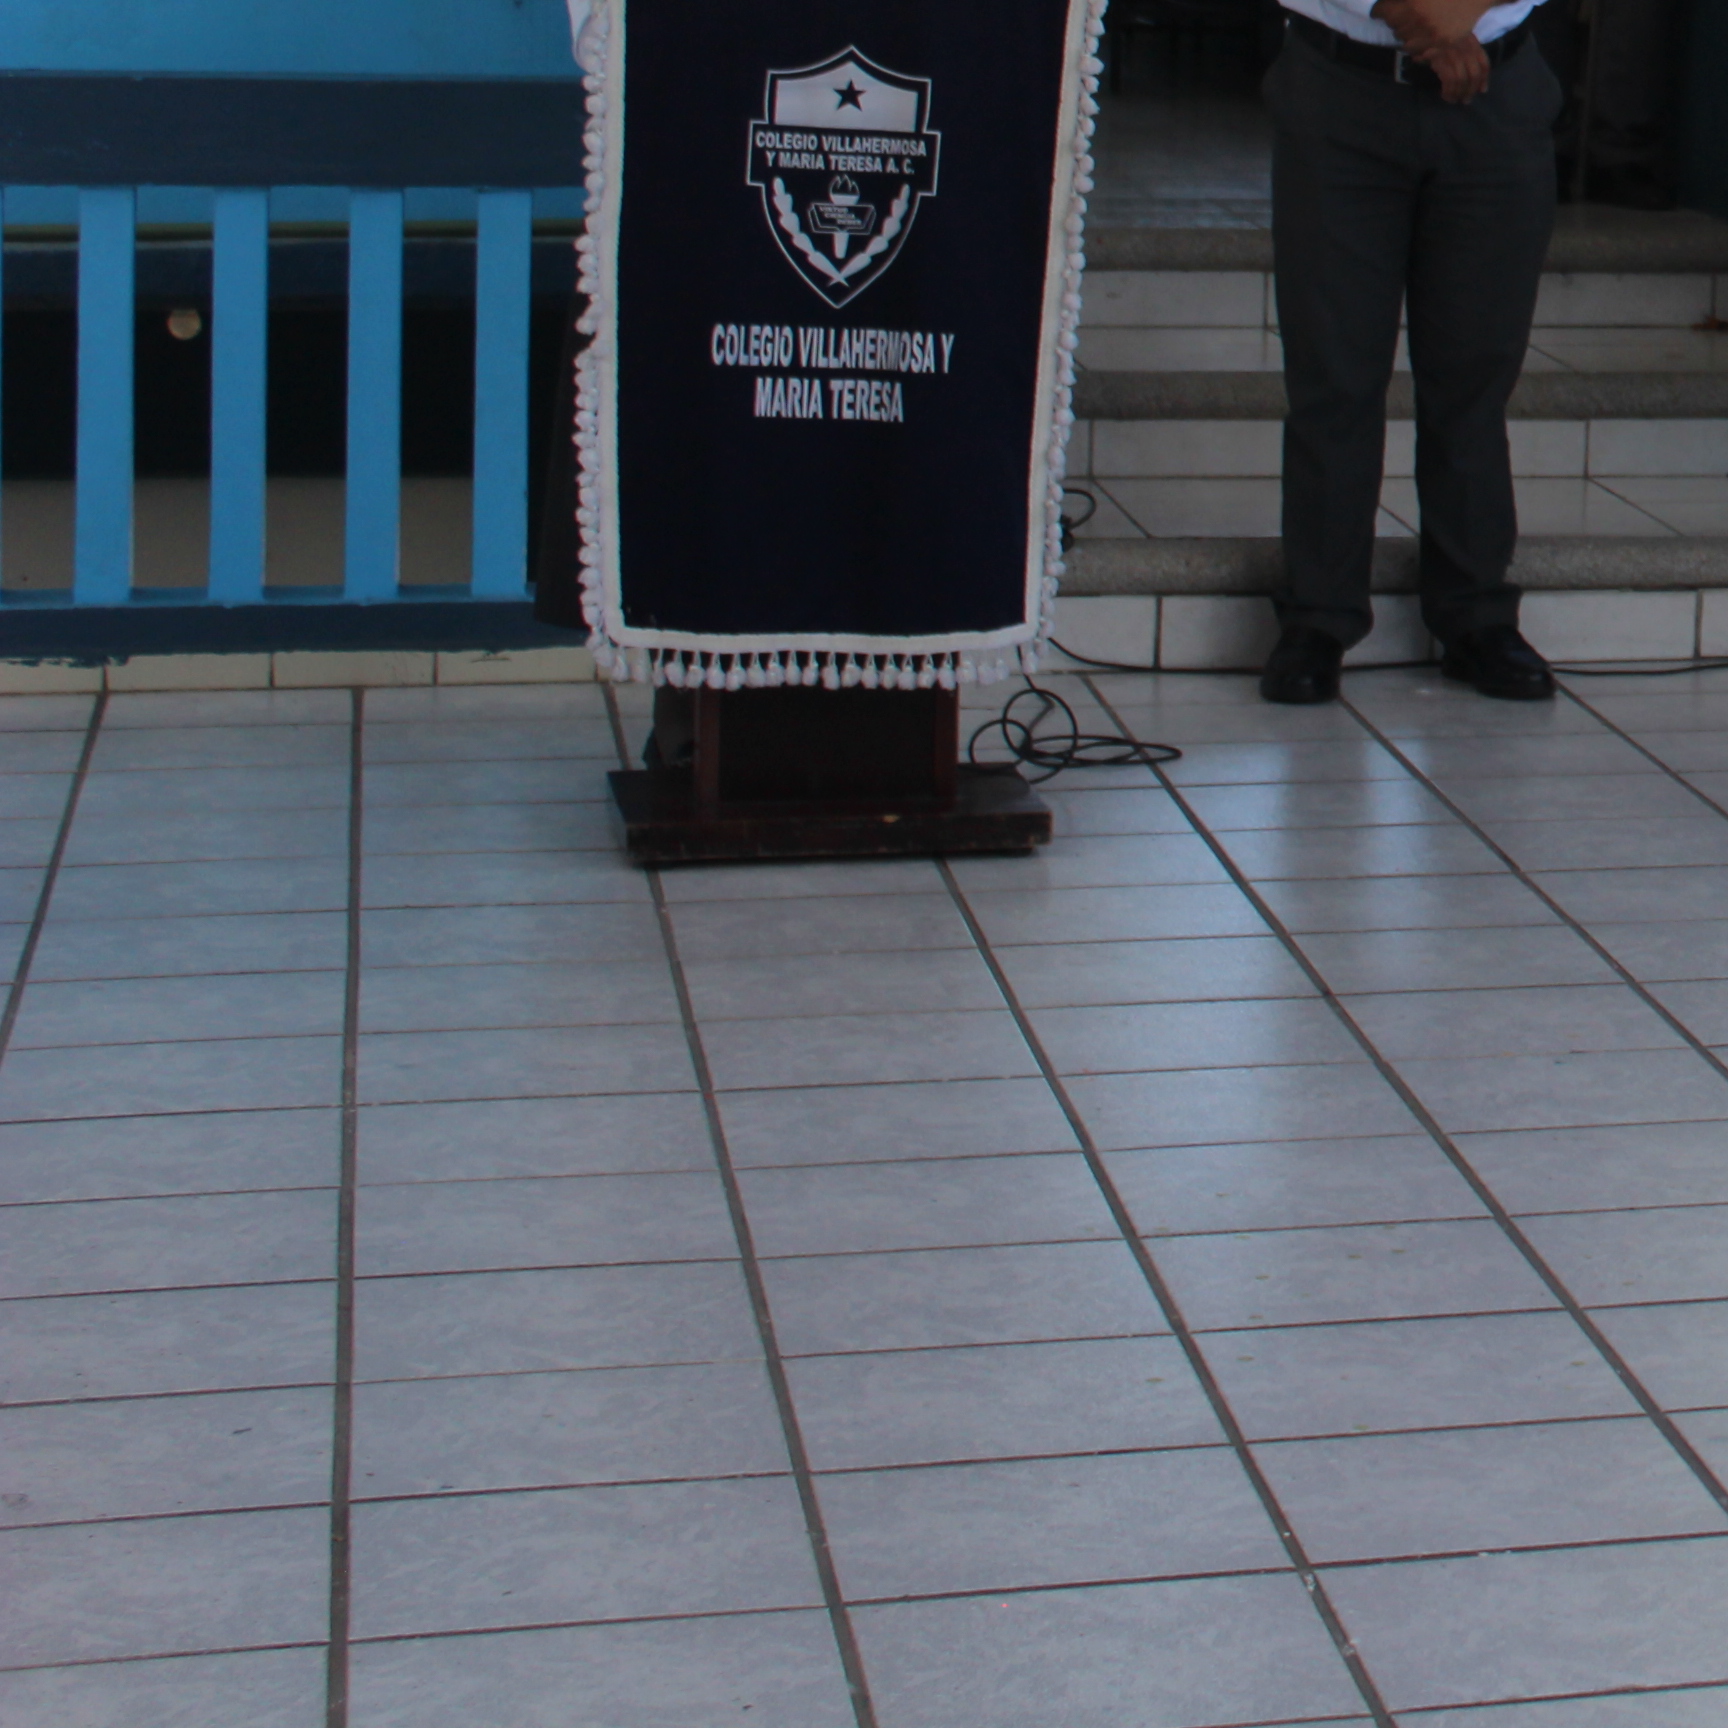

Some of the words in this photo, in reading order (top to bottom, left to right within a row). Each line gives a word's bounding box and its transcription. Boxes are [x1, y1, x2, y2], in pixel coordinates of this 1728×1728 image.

[755, 131, 817, 150] COLEGIO
[822, 135, 927, 157] VILLAHERMOSA
[766, 151, 776, 167] Y
[779, 152, 825, 170] MARIA
[829, 154, 882, 172] TERESA
[886, 158, 900, 173] A.
[903, 159, 915, 174] C.
[711, 324, 794, 367] COLEGIO
[799, 326, 935, 373] VILLAHERMOSA
[941, 333, 955, 373] Y
[754, 377, 823, 419] MARIA
[829, 379, 904, 423] TERESA
